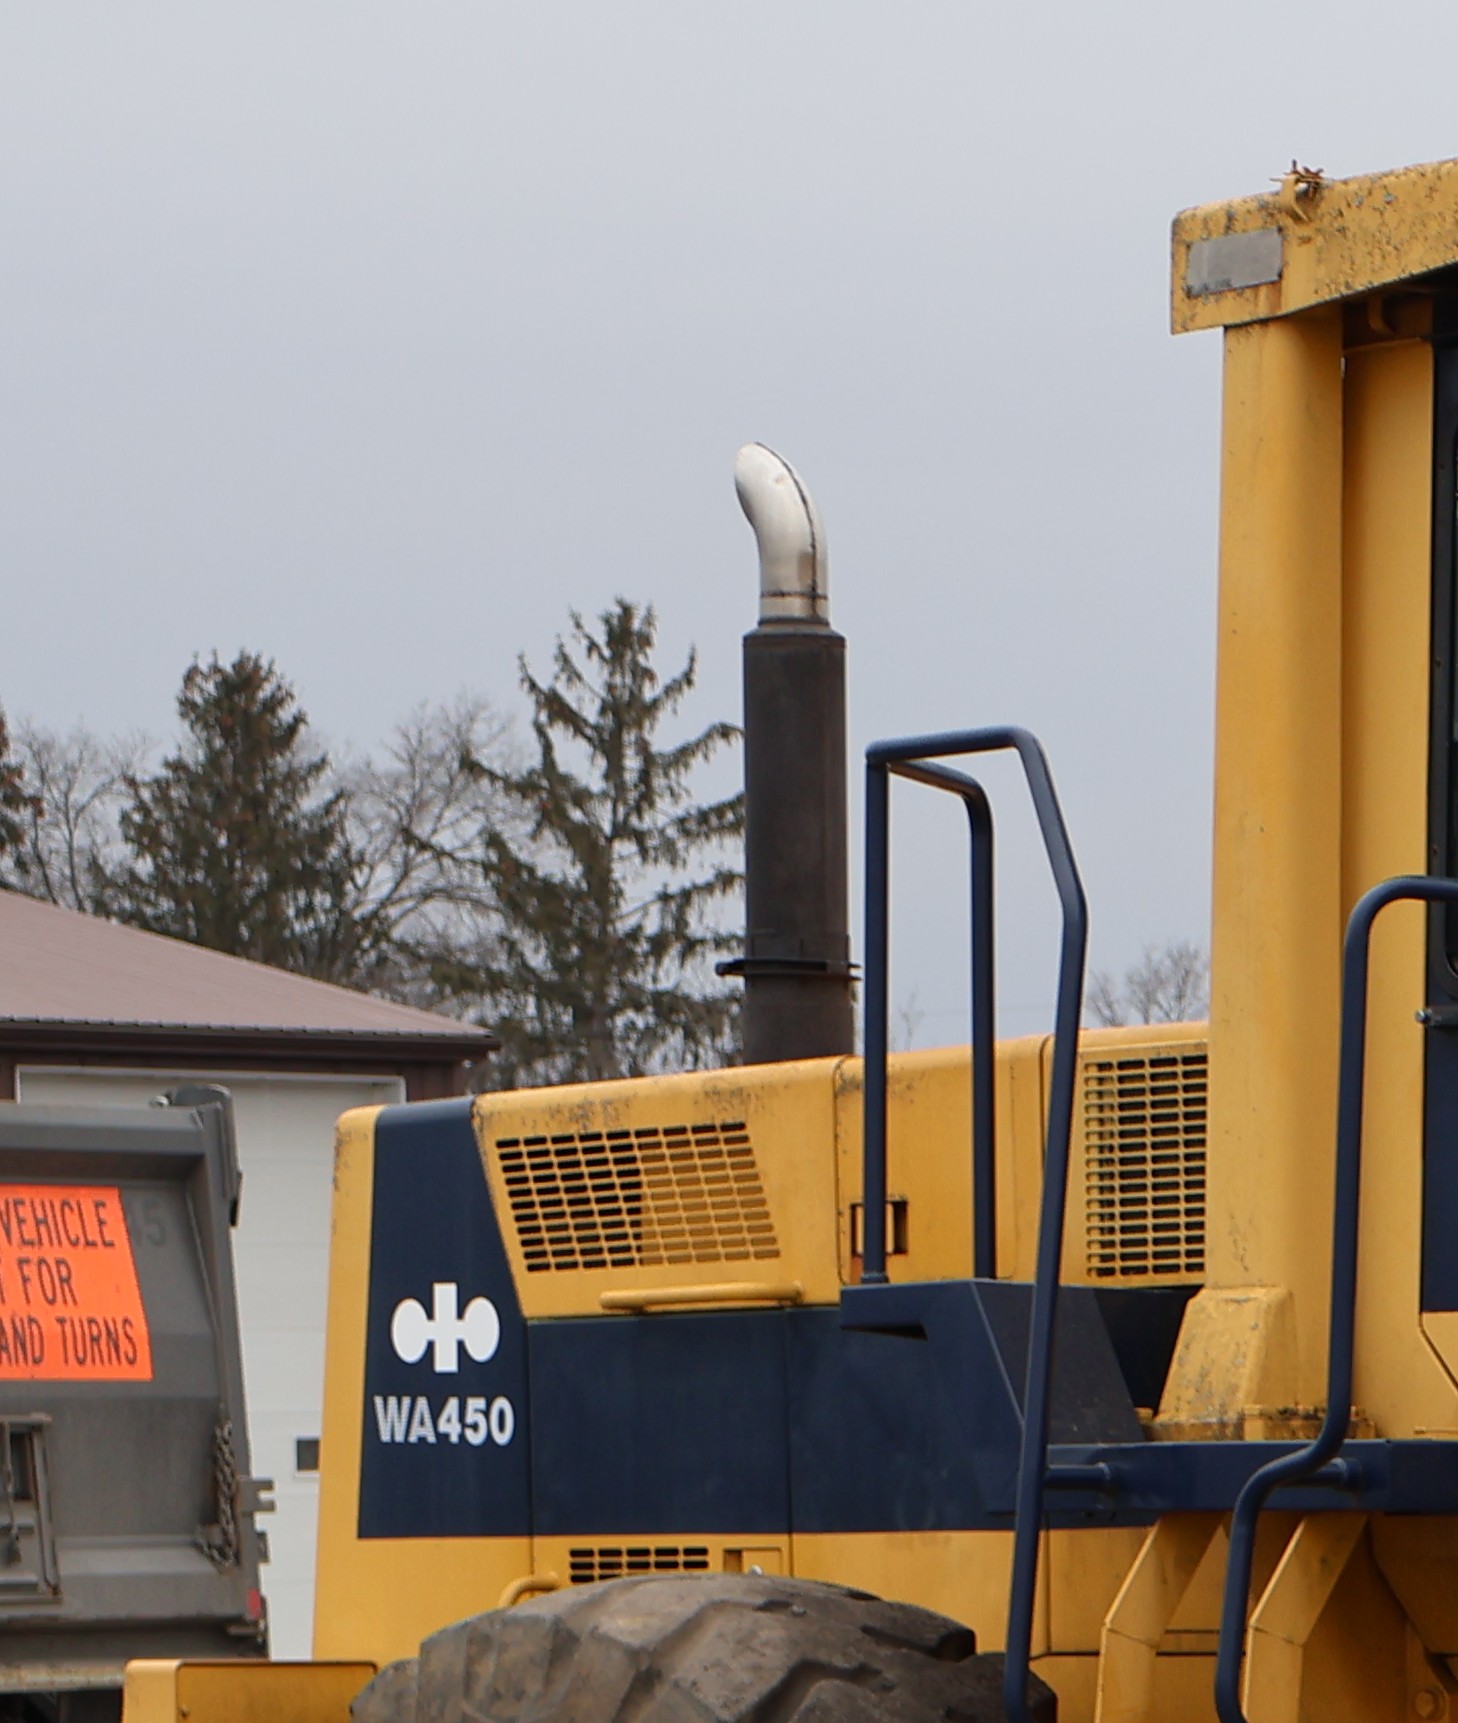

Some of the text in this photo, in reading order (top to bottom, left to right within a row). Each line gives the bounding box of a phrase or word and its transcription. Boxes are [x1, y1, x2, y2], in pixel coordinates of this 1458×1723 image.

[0, 1198, 115, 1247] VEHICLE
[17, 1257, 78, 1306] FOR
[0, 1315, 138, 1367] AND TURNS
[373, 1395, 515, 1446] WA450
